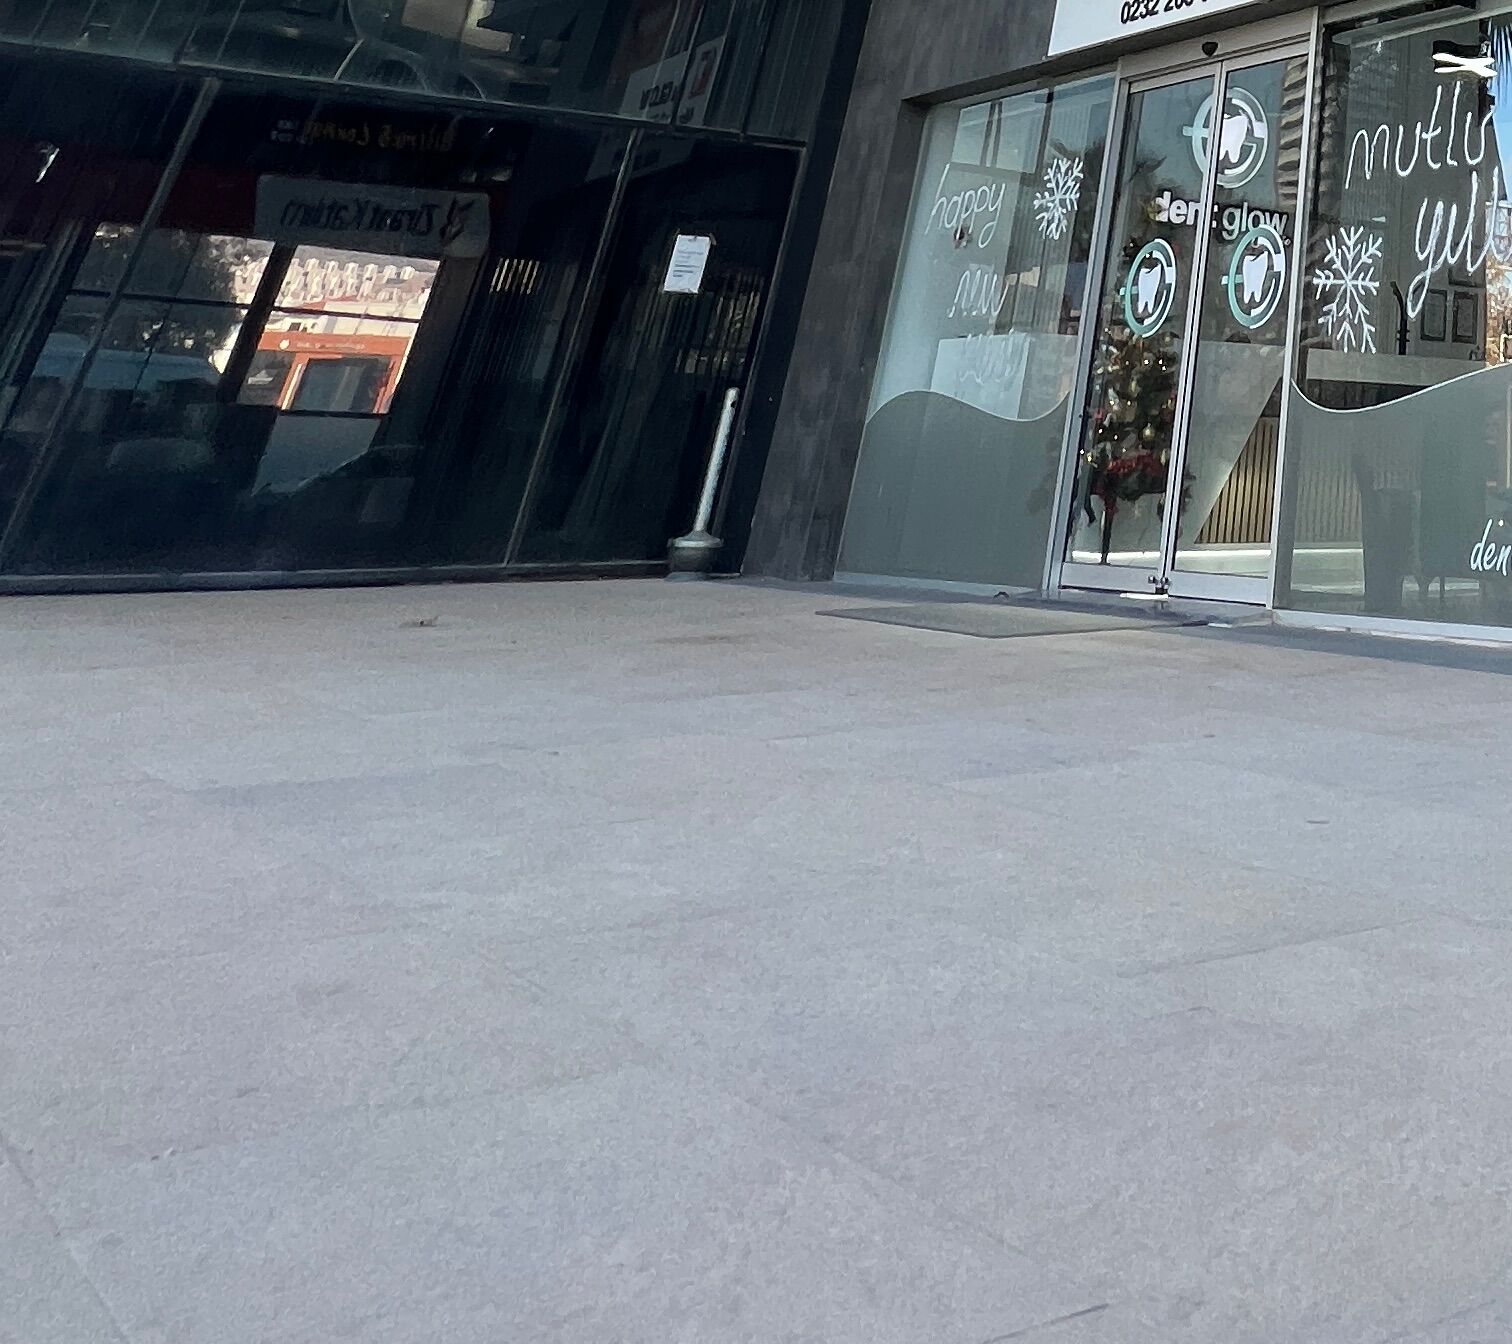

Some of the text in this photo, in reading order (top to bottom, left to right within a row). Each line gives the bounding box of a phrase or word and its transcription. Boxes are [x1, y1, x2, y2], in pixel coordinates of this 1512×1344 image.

[1345, 80, 1496, 189] mutlu
[924, 163, 1006, 249] happy
[1222, 201, 1289, 241] glow
